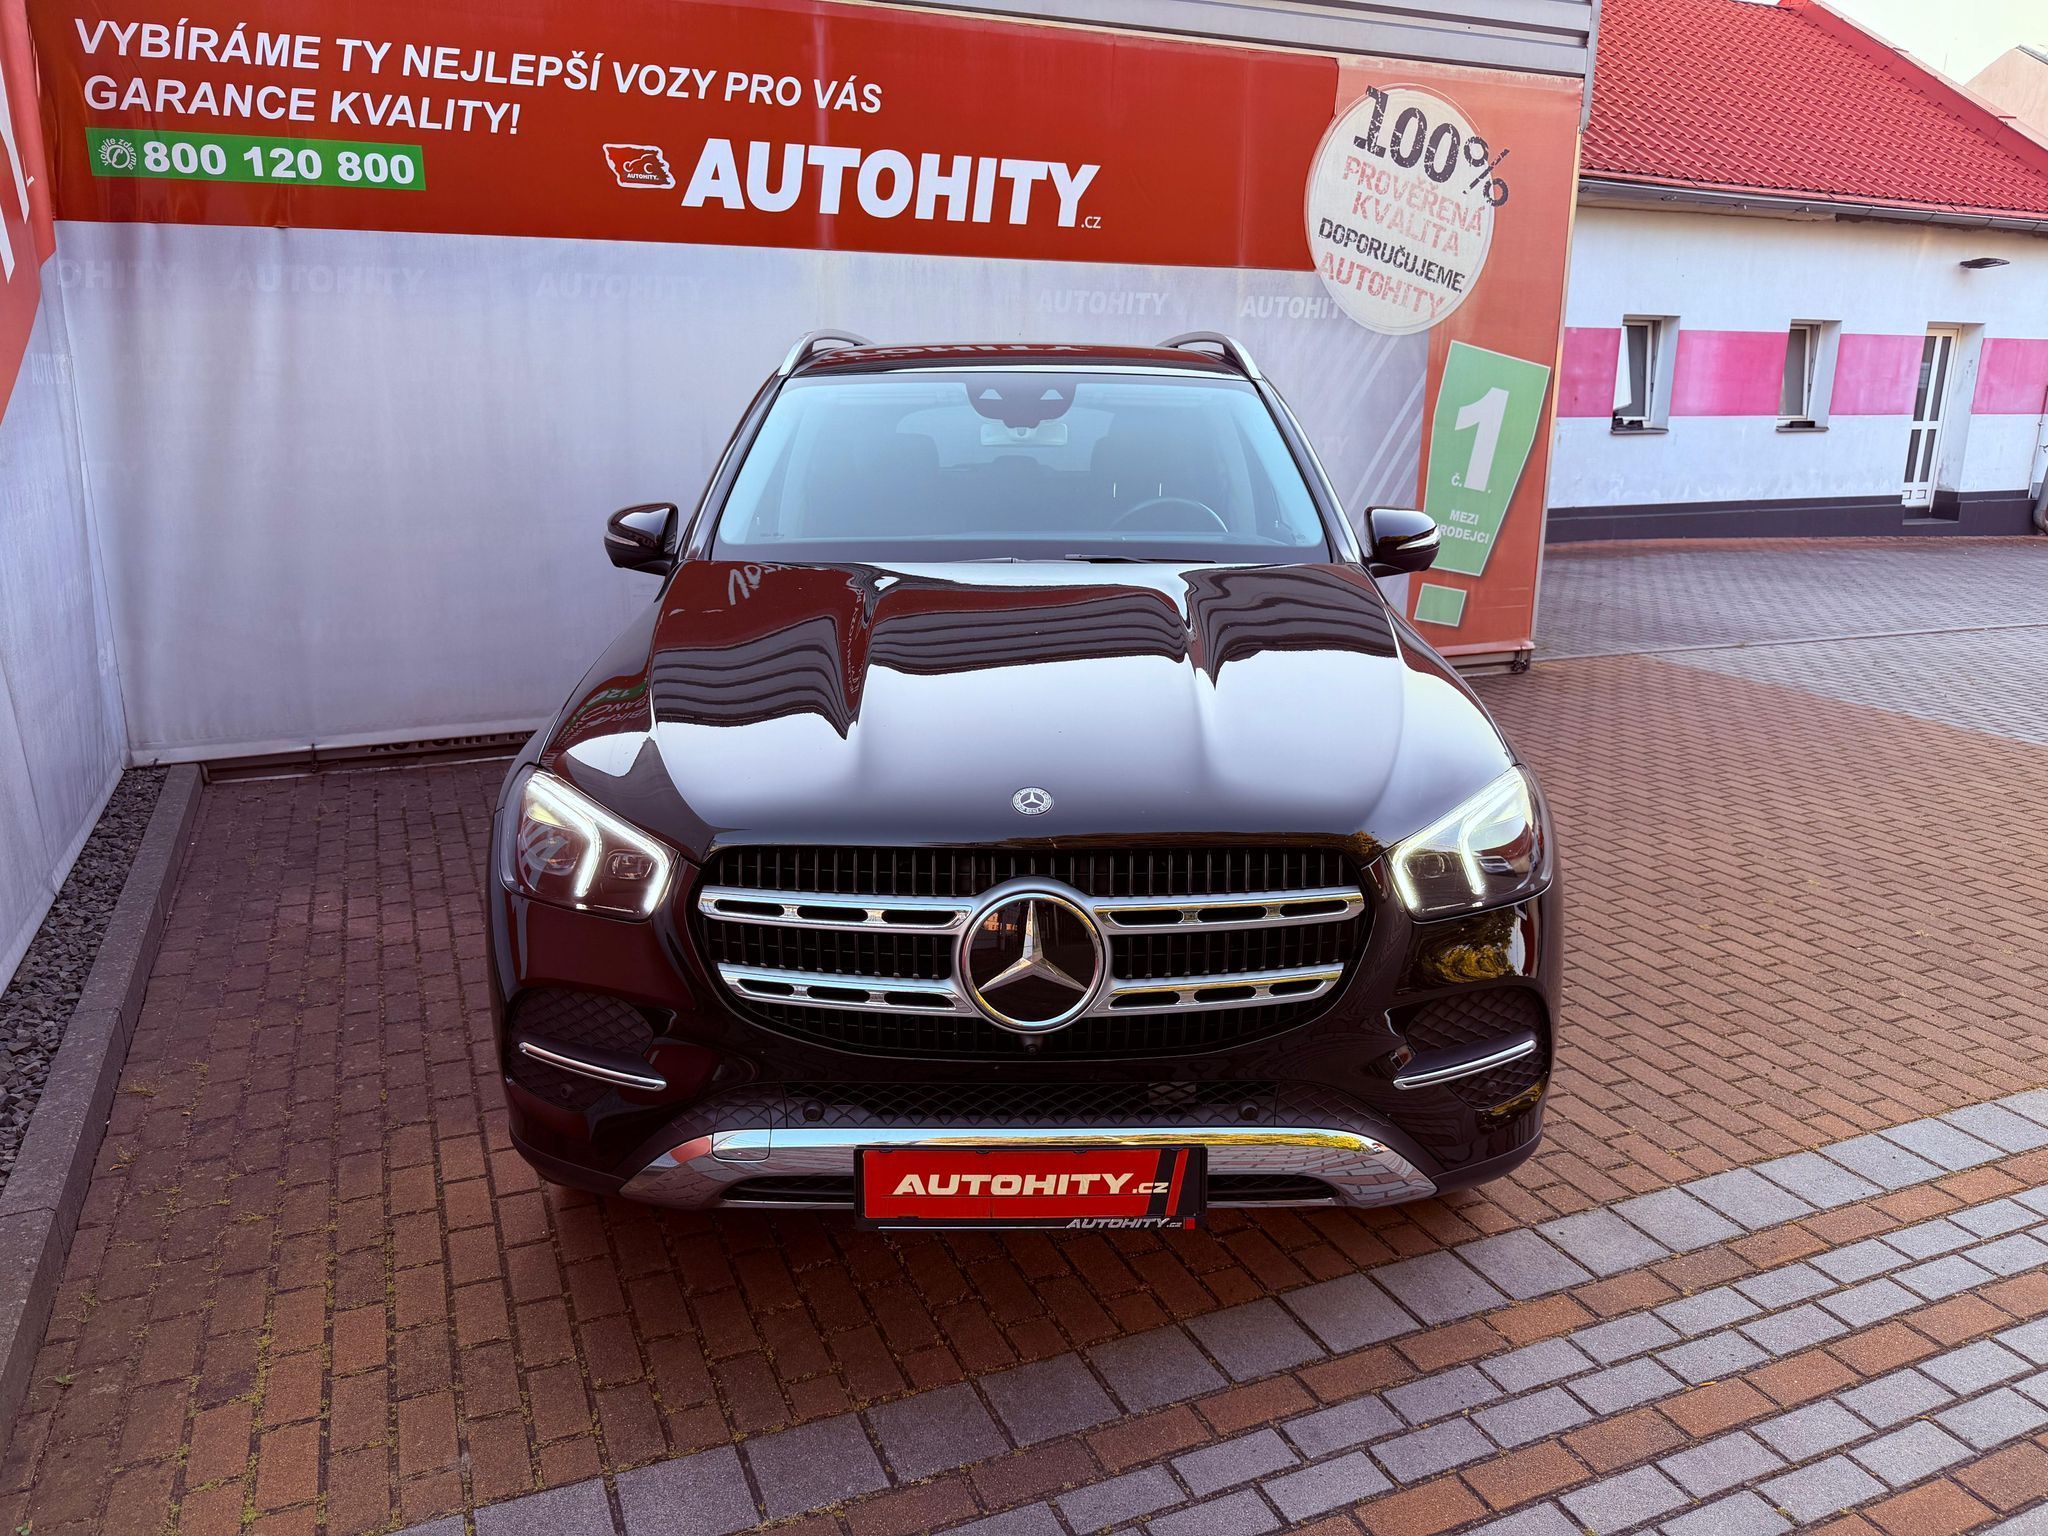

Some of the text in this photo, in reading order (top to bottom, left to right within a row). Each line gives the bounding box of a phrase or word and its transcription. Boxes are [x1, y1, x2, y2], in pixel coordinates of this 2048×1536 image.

[75, 18, 883, 113] VYBÍRÁME TY NEJLEPŠÍ VOZY PRO VÁS
[84, 75, 520, 135] GARANCE KVALITY!
[143, 141, 415, 184] 800 120 800
[1353, 85, 1509, 207] 100%
[1342, 155, 1485, 236] PROVĚŘENÁ
[1352, 191, 1459, 256] KVALITA
[229, 263, 429, 295] AUTOHITY
[1318, 217, 1465, 293] DOPORUČUJEME
[1037, 288, 1169, 317] AUTOHITY
[1240, 295, 1350, 320] AUTOHIT
[1319, 251, 1446, 319] AUTOHITY
[1437, 523, 1490, 545] RODEJCI
[1450, 510, 1479, 526] MEZI
[892, 1172, 1169, 1197] AUTOHITY.cz
